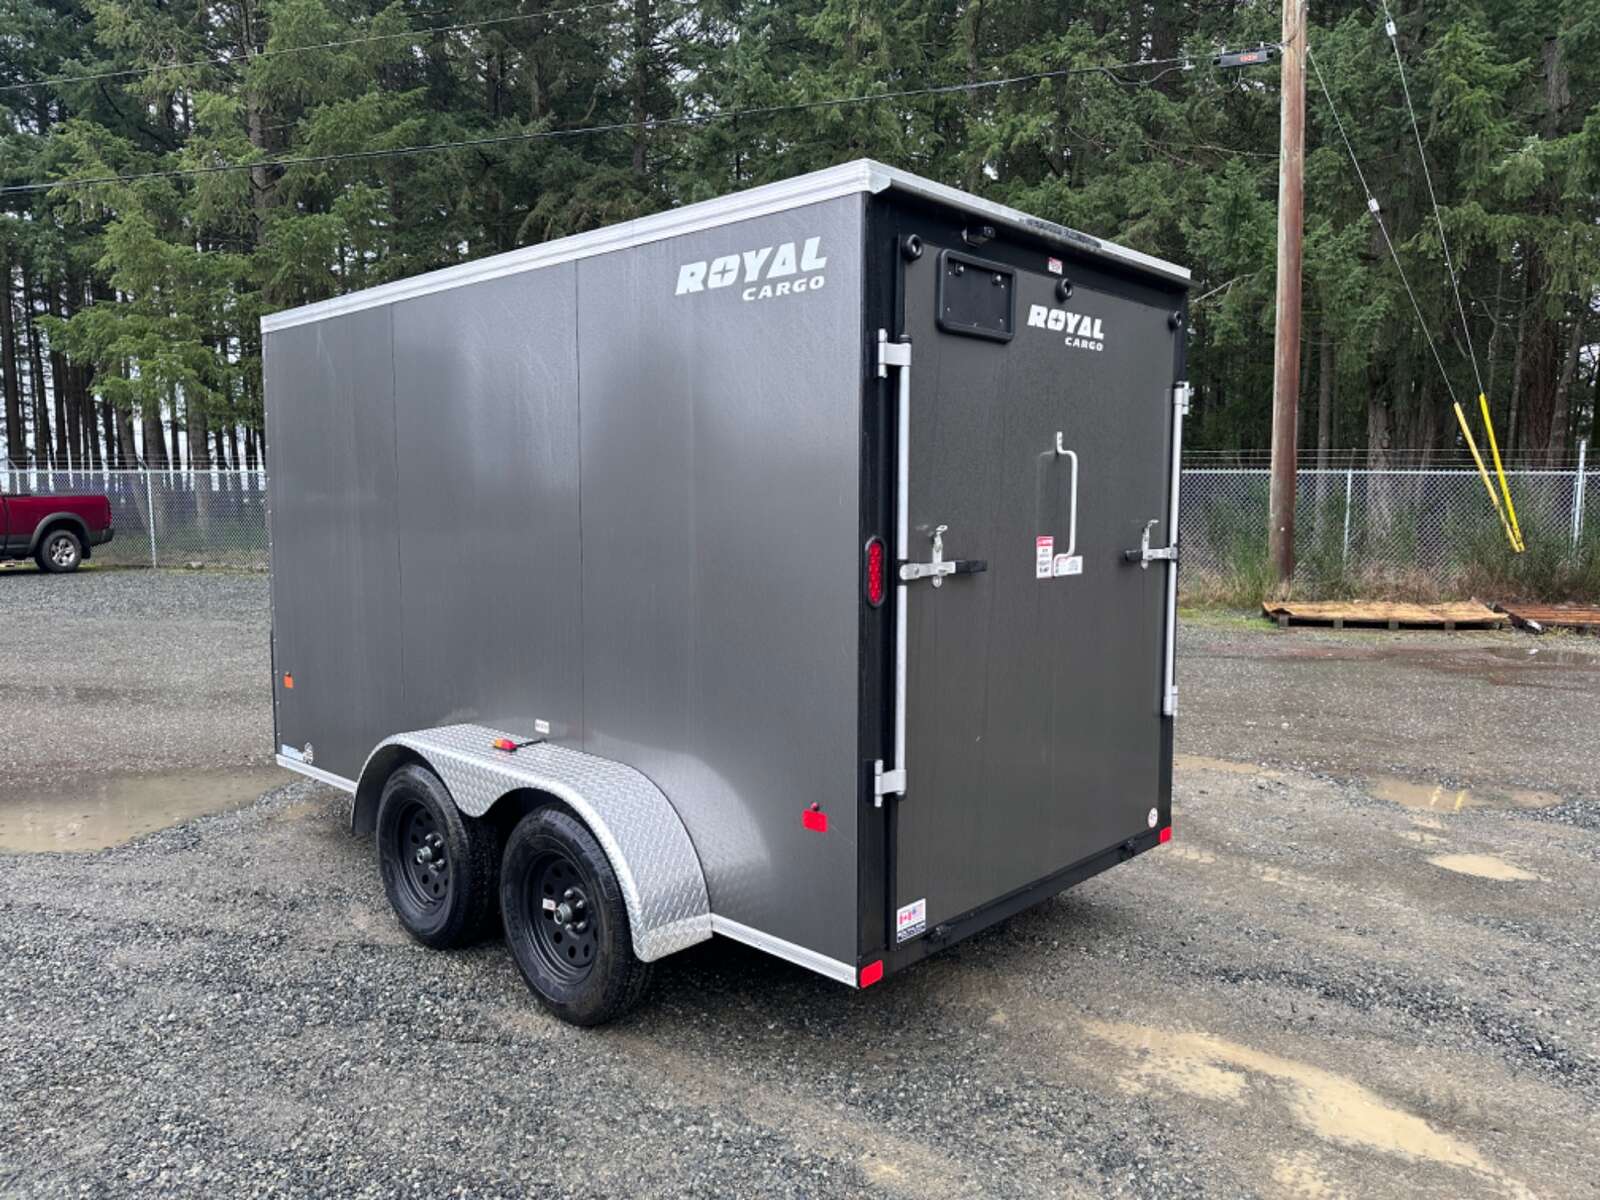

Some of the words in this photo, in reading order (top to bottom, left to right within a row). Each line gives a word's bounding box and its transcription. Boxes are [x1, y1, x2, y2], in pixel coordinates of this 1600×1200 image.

[675, 236, 827, 296] ROYAL
[742, 275, 825, 301] CARGO
[1027, 304, 1104, 340] ROYAL
[1064, 336, 1104, 351] CARGO
